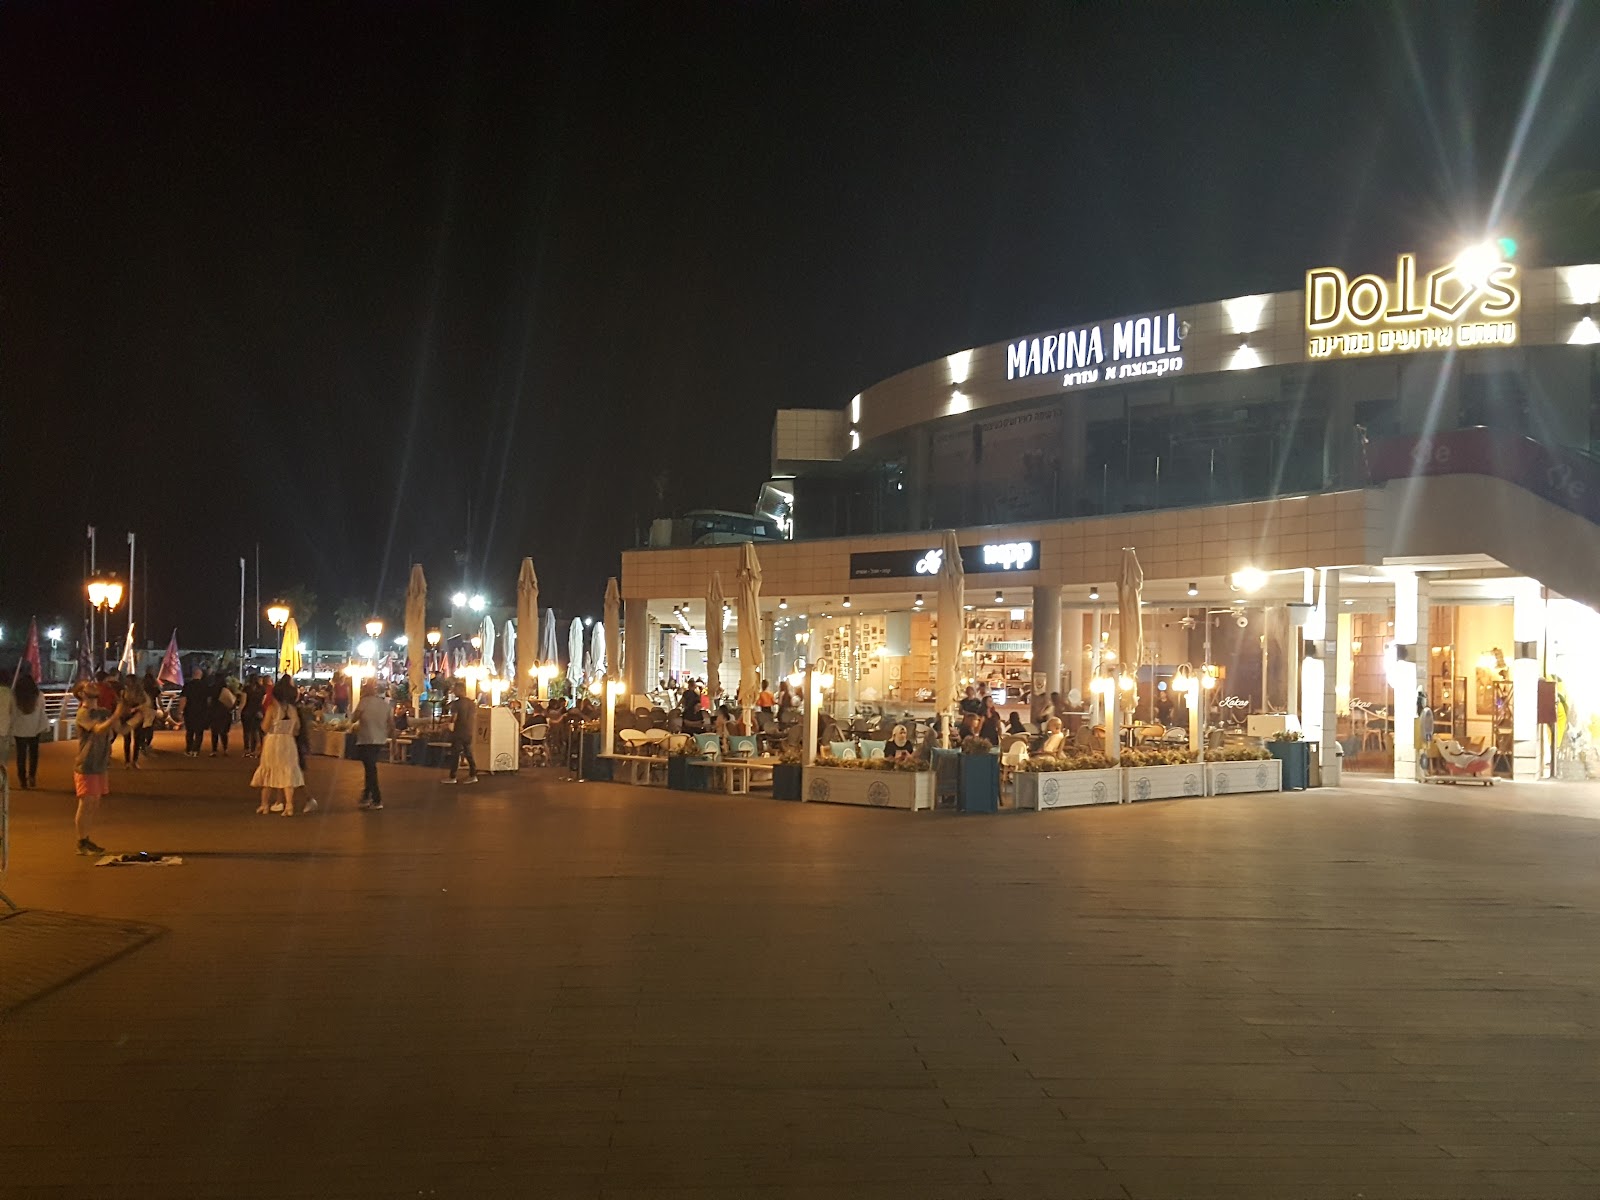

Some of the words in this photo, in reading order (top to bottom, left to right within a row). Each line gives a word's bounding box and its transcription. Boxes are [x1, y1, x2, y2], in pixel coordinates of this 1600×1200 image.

[1310, 333, 1374, 356] במרינה
[1379, 325, 1452, 348] אירועים
[1459, 322, 1515, 345] מתחם
[1007, 326, 1104, 380] MARINA
[1113, 313, 1181, 361] MALL
[1063, 369, 1098, 386] עזרא
[1119, 356, 1183, 379] מקבוצת
[1218, 696, 1250, 709] Kakao
